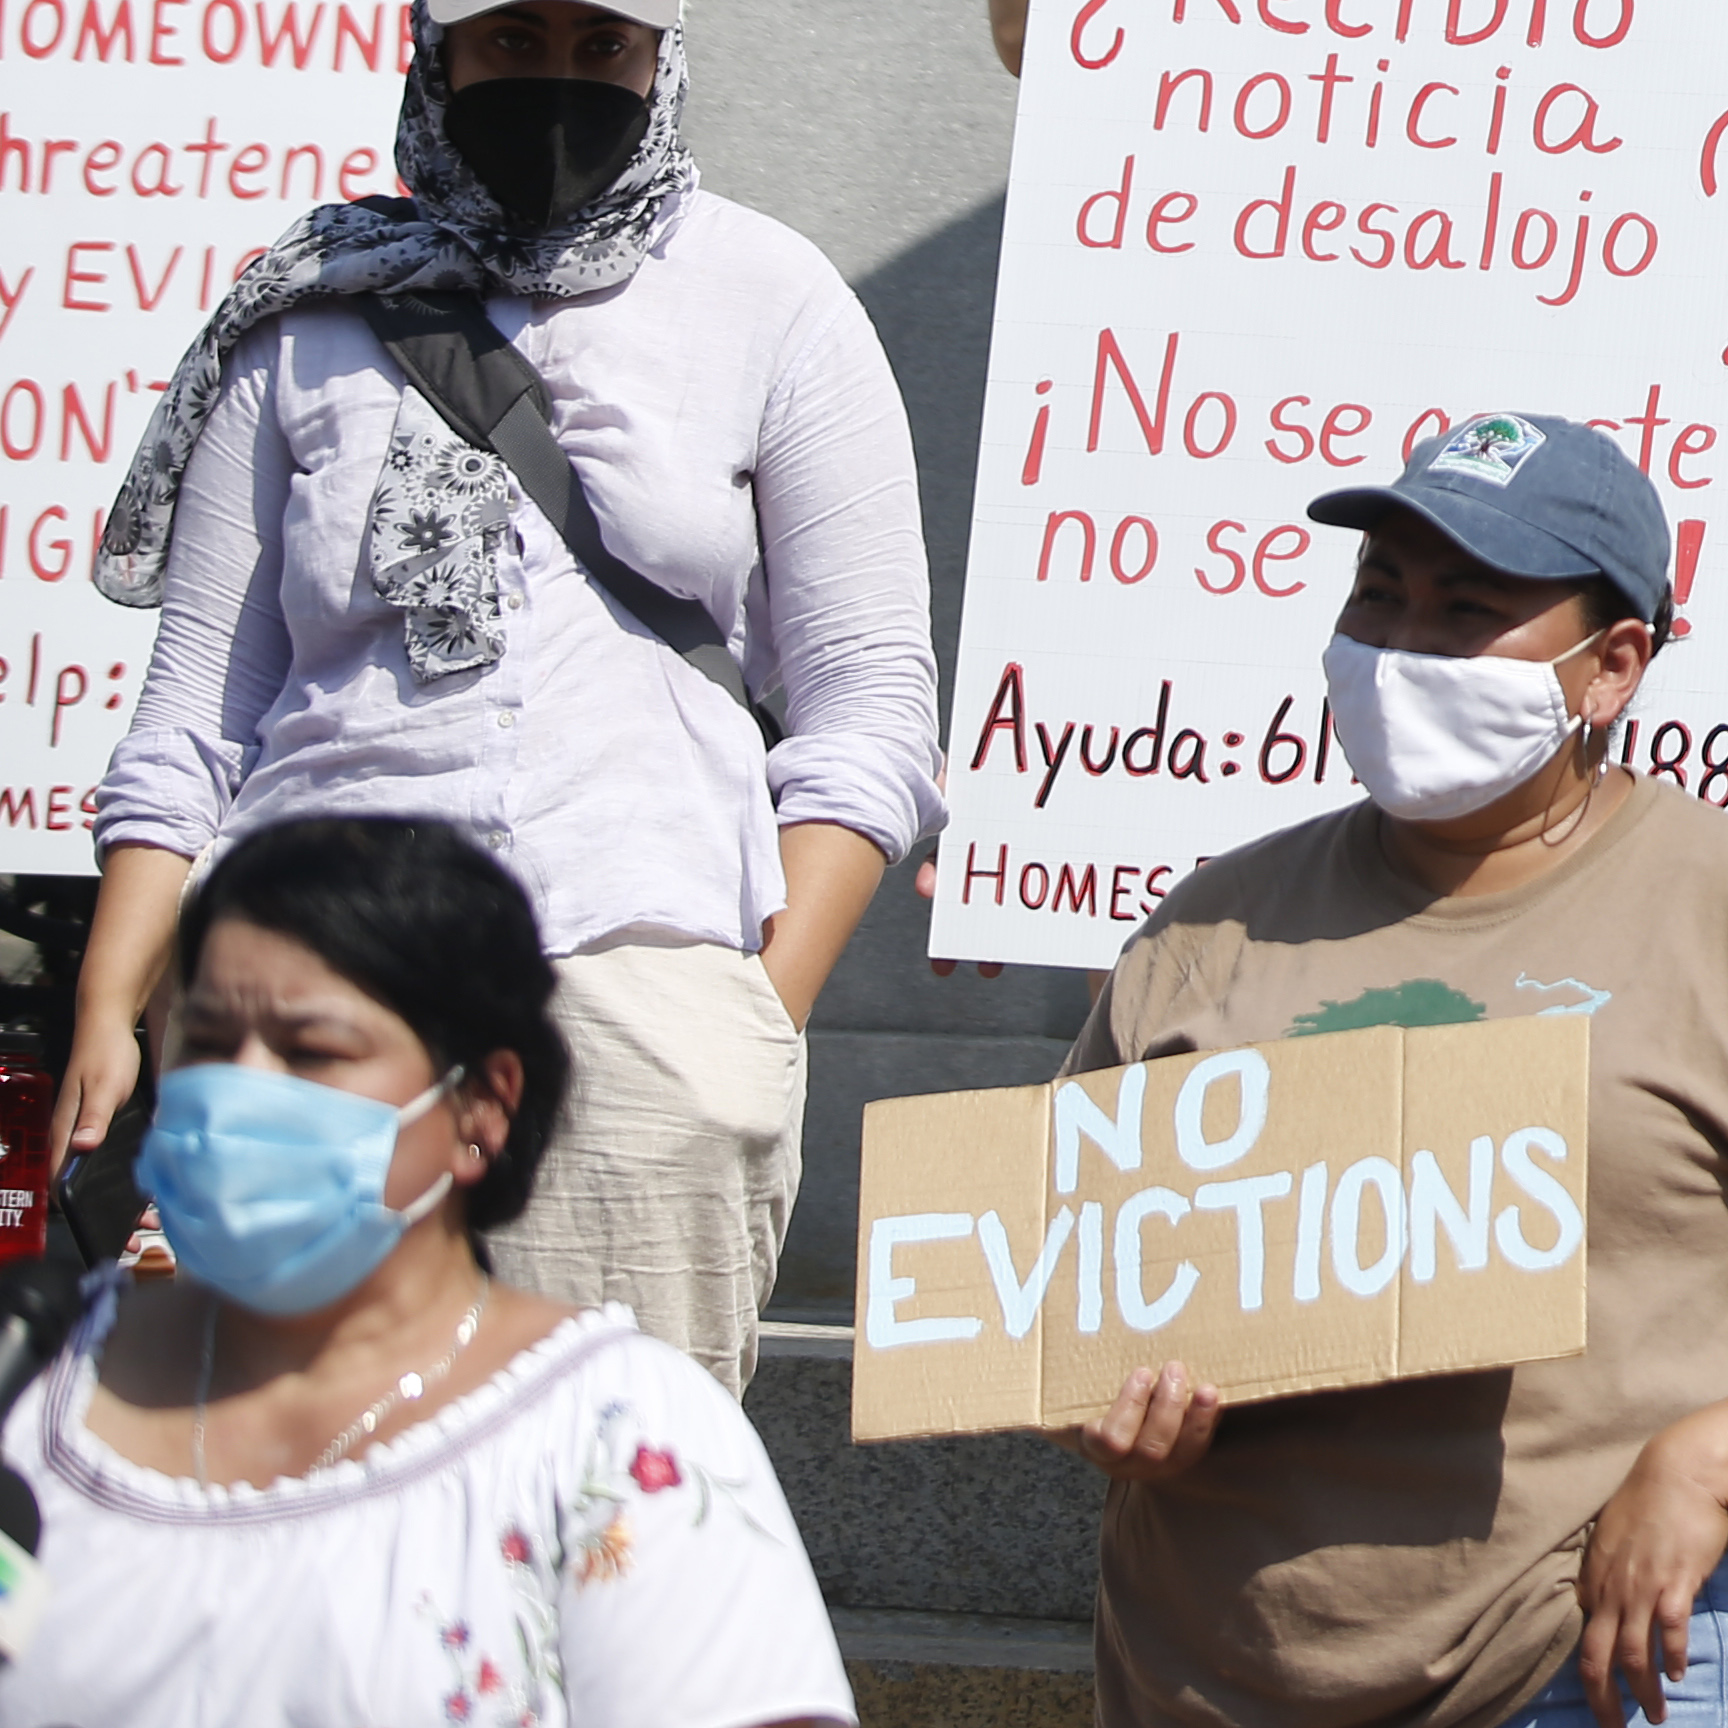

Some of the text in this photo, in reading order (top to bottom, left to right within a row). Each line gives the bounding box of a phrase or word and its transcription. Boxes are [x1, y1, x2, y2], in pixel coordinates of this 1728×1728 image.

[1151, 54, 1625, 156] noticia
[1075, 155, 1659, 306] de desalojo
[1265, 396, 1372, 468] se
[1036, 509, 1159, 584] no
[1194, 519, 1311, 598] se
[1051, 1047, 1272, 1194] NO
[864, 1126, 1586, 1349] EVICTIONS
